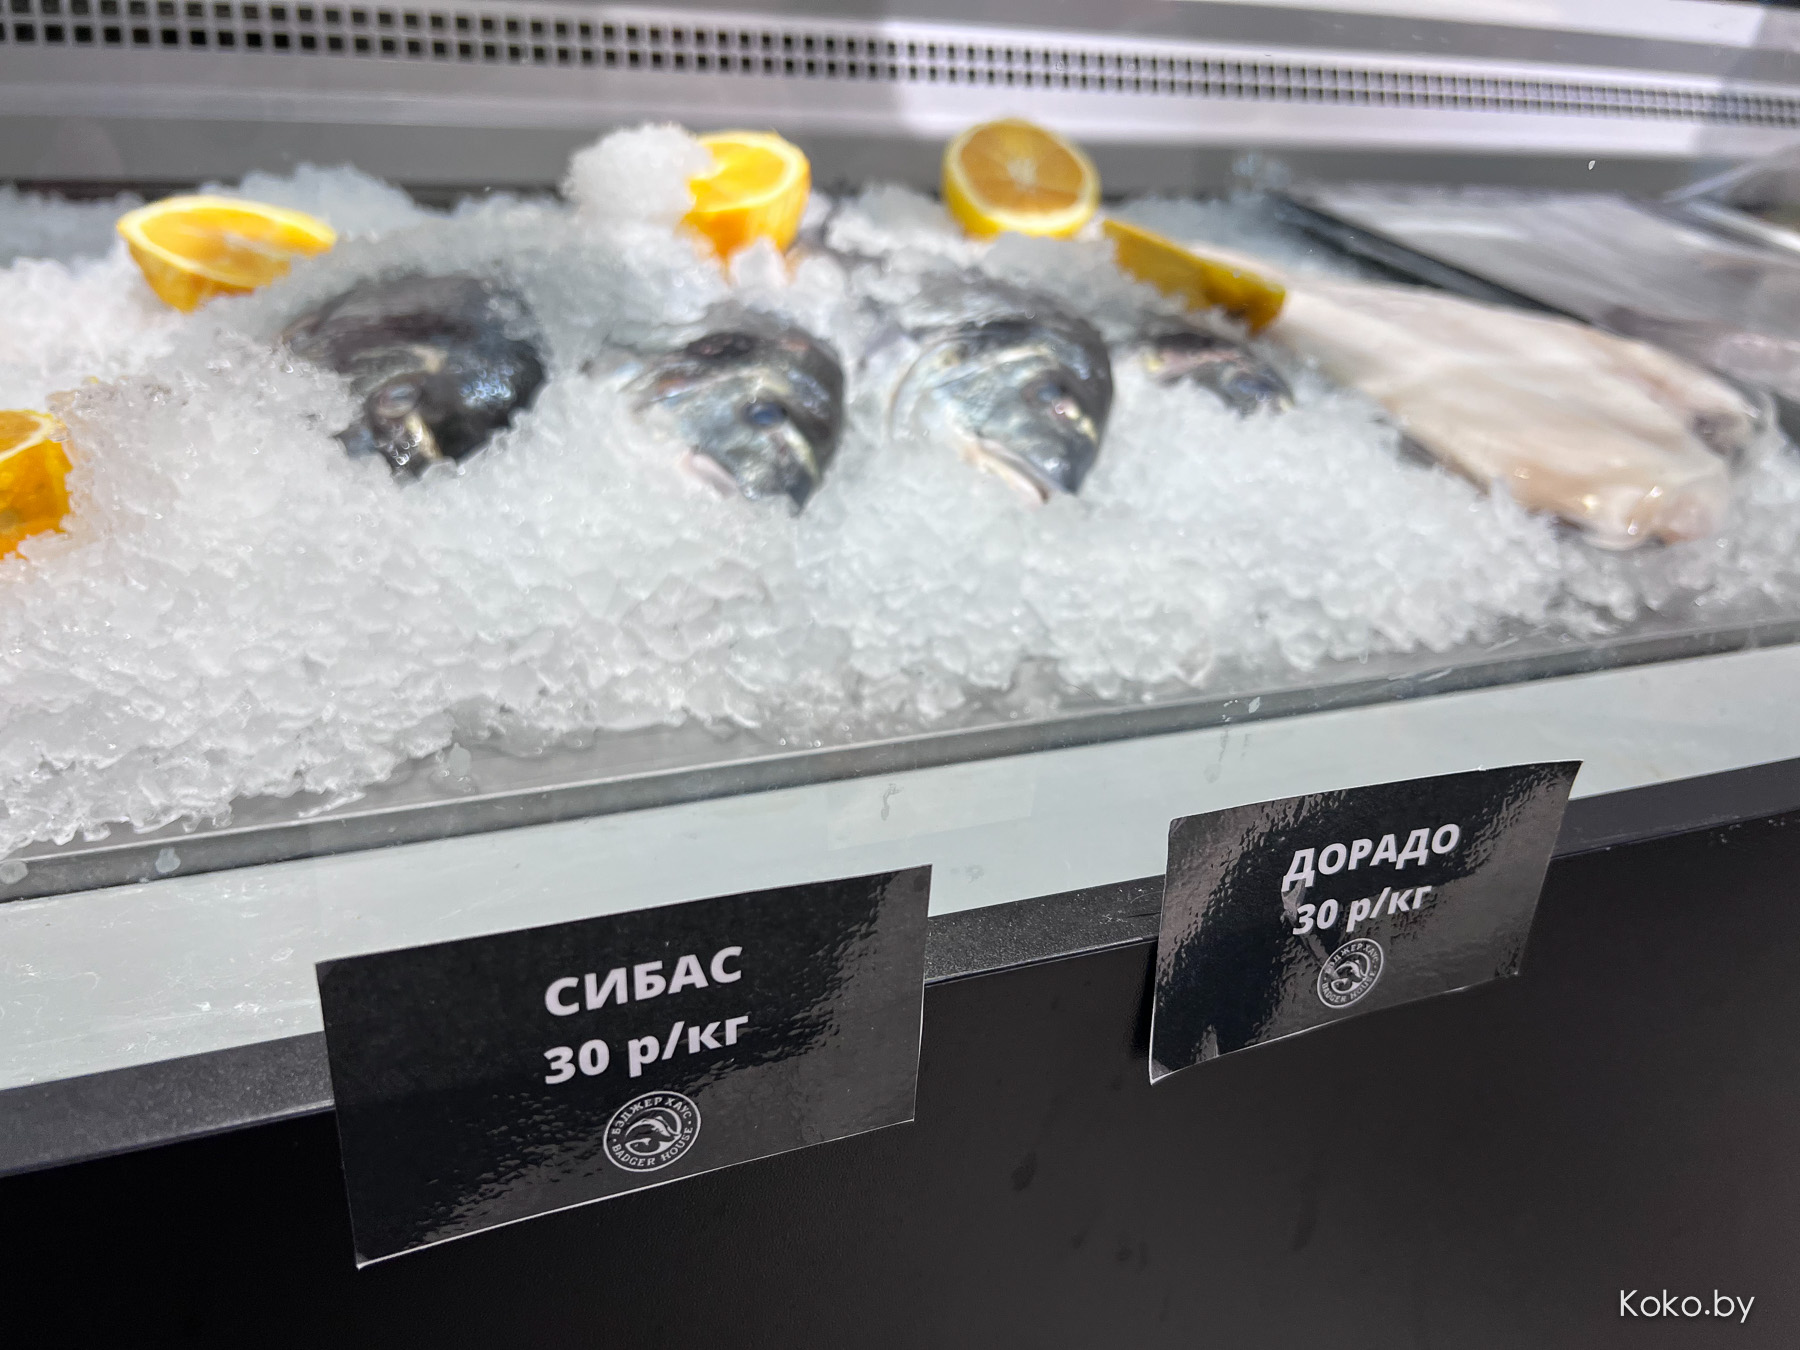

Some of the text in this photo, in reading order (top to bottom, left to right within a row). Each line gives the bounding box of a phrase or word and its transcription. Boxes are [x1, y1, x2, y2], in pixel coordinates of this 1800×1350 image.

[1281, 823, 1460, 892] ДОРАДО
[1292, 885, 1432, 935] 30 р/кг
[545, 945, 742, 1016] СИБАС
[543, 1015, 749, 1084] 30 р/кг
[611, 1096, 693, 1135] БЭДЖЕР ХАУС
[611, 1127, 693, 1167] BADGER HOUSE
